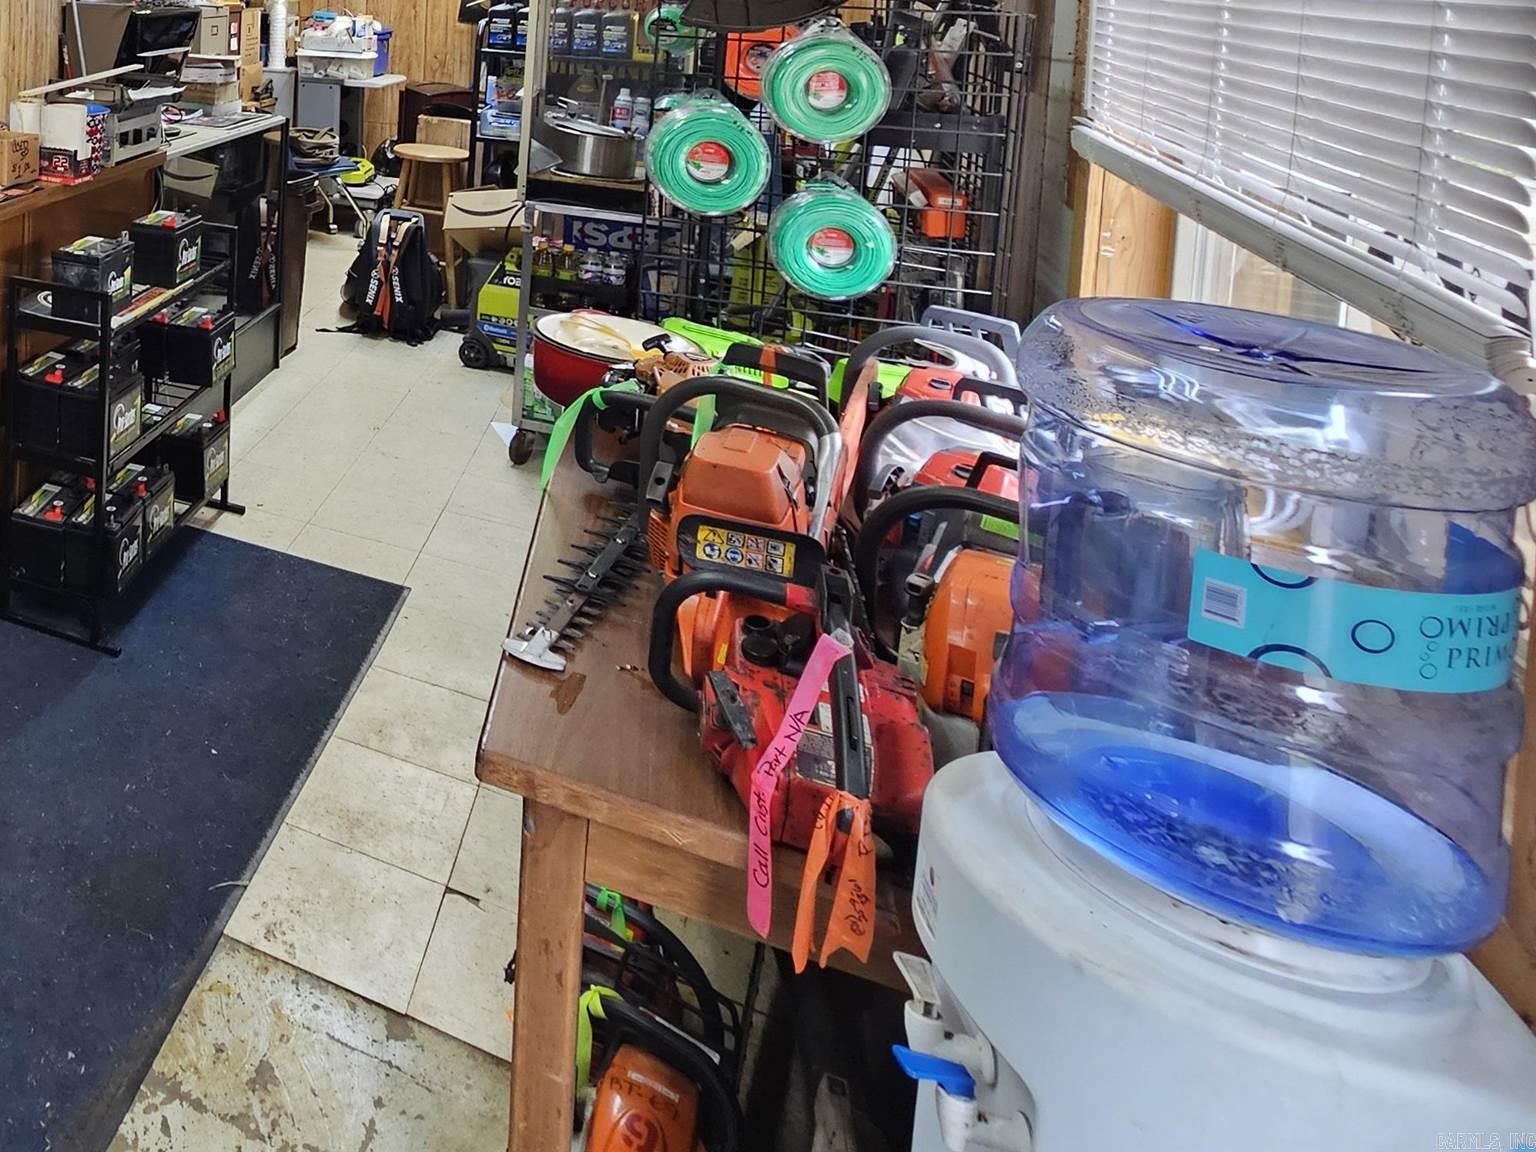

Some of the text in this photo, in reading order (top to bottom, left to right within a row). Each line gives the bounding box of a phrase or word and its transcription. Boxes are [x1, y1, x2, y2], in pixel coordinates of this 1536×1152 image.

[53, 155, 69, 168] 22
[572, 220, 682, 255] PEPSI
[365, 279, 379, 307] SENIX
[392, 275, 405, 304] SENIX
[1419, 613, 1511, 639] PRIMO
[757, 746, 787, 778] Part
[752, 842, 769, 889] Call
